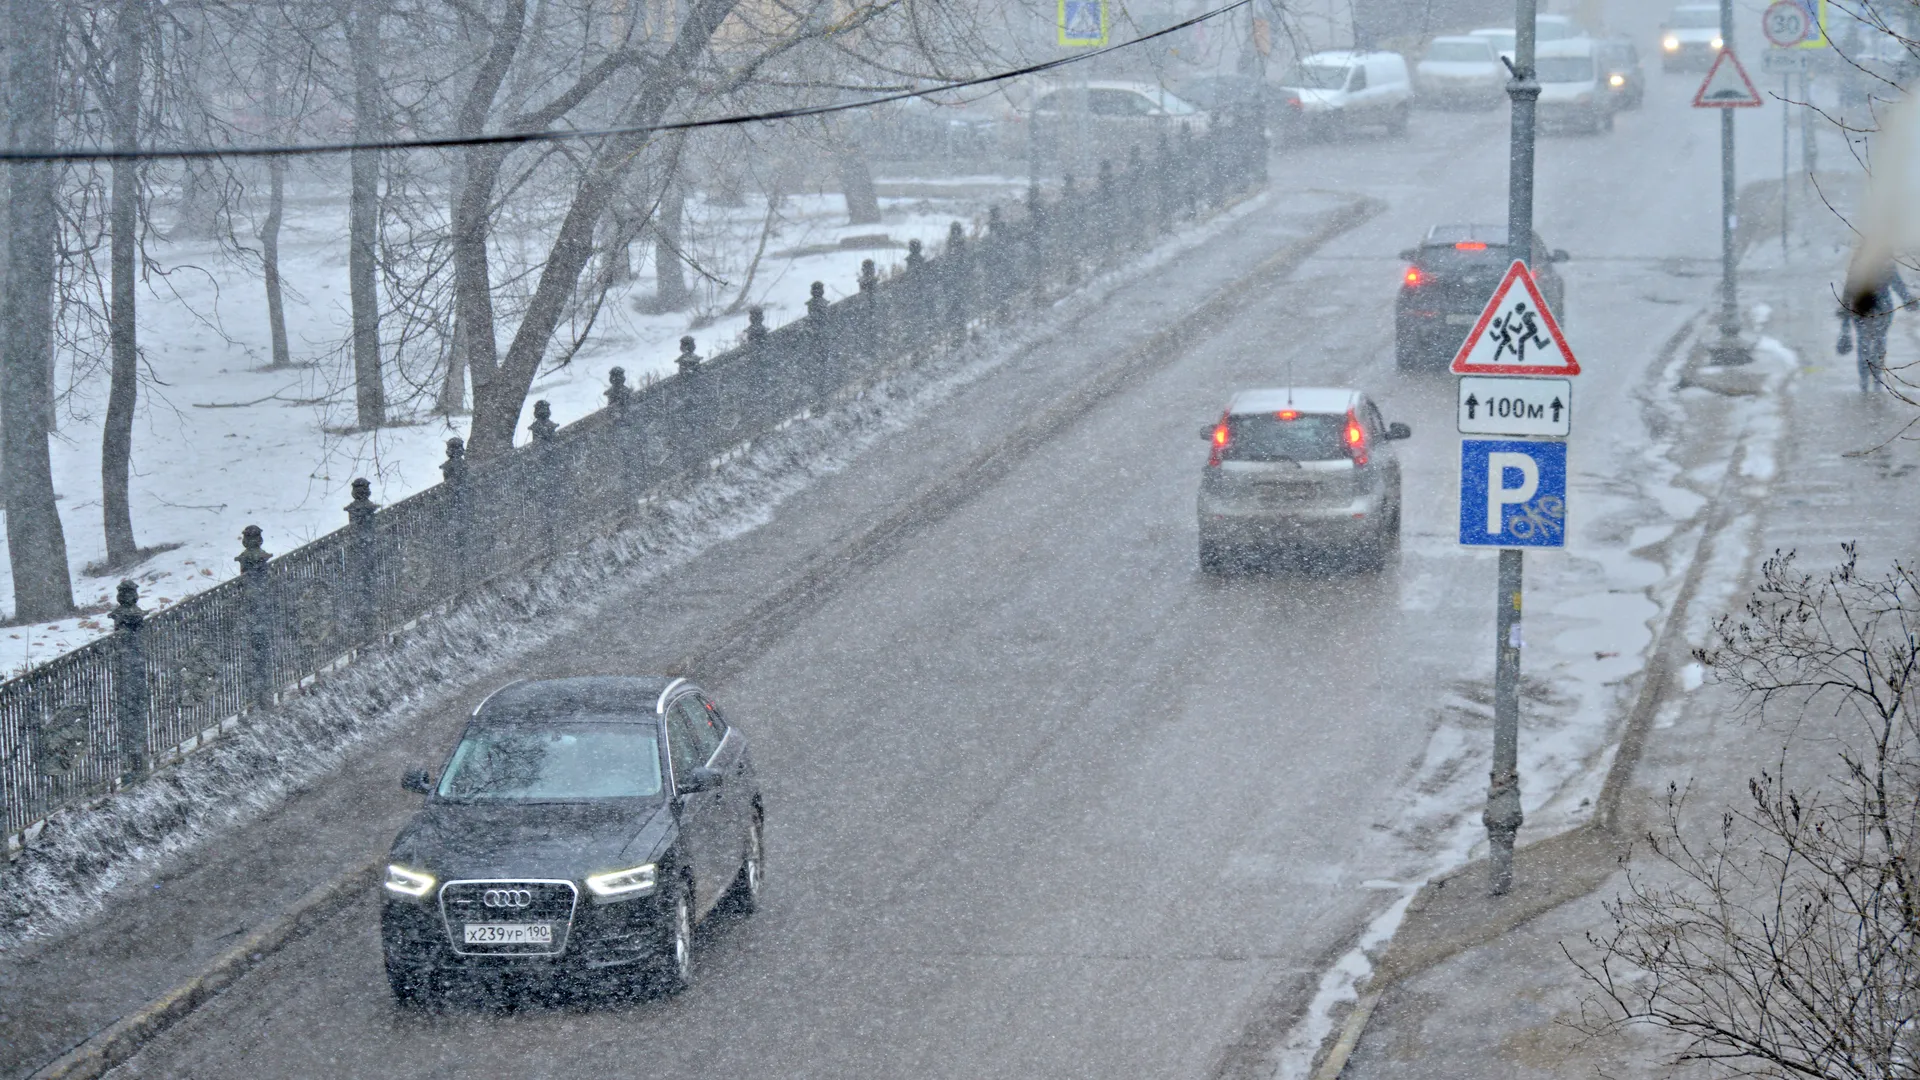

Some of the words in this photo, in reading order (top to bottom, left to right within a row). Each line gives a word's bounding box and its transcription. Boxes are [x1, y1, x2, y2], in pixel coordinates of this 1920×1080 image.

[1773, 14, 1800, 34] 30
[1486, 451, 1540, 534] P
[526, 925, 548, 937] 190
